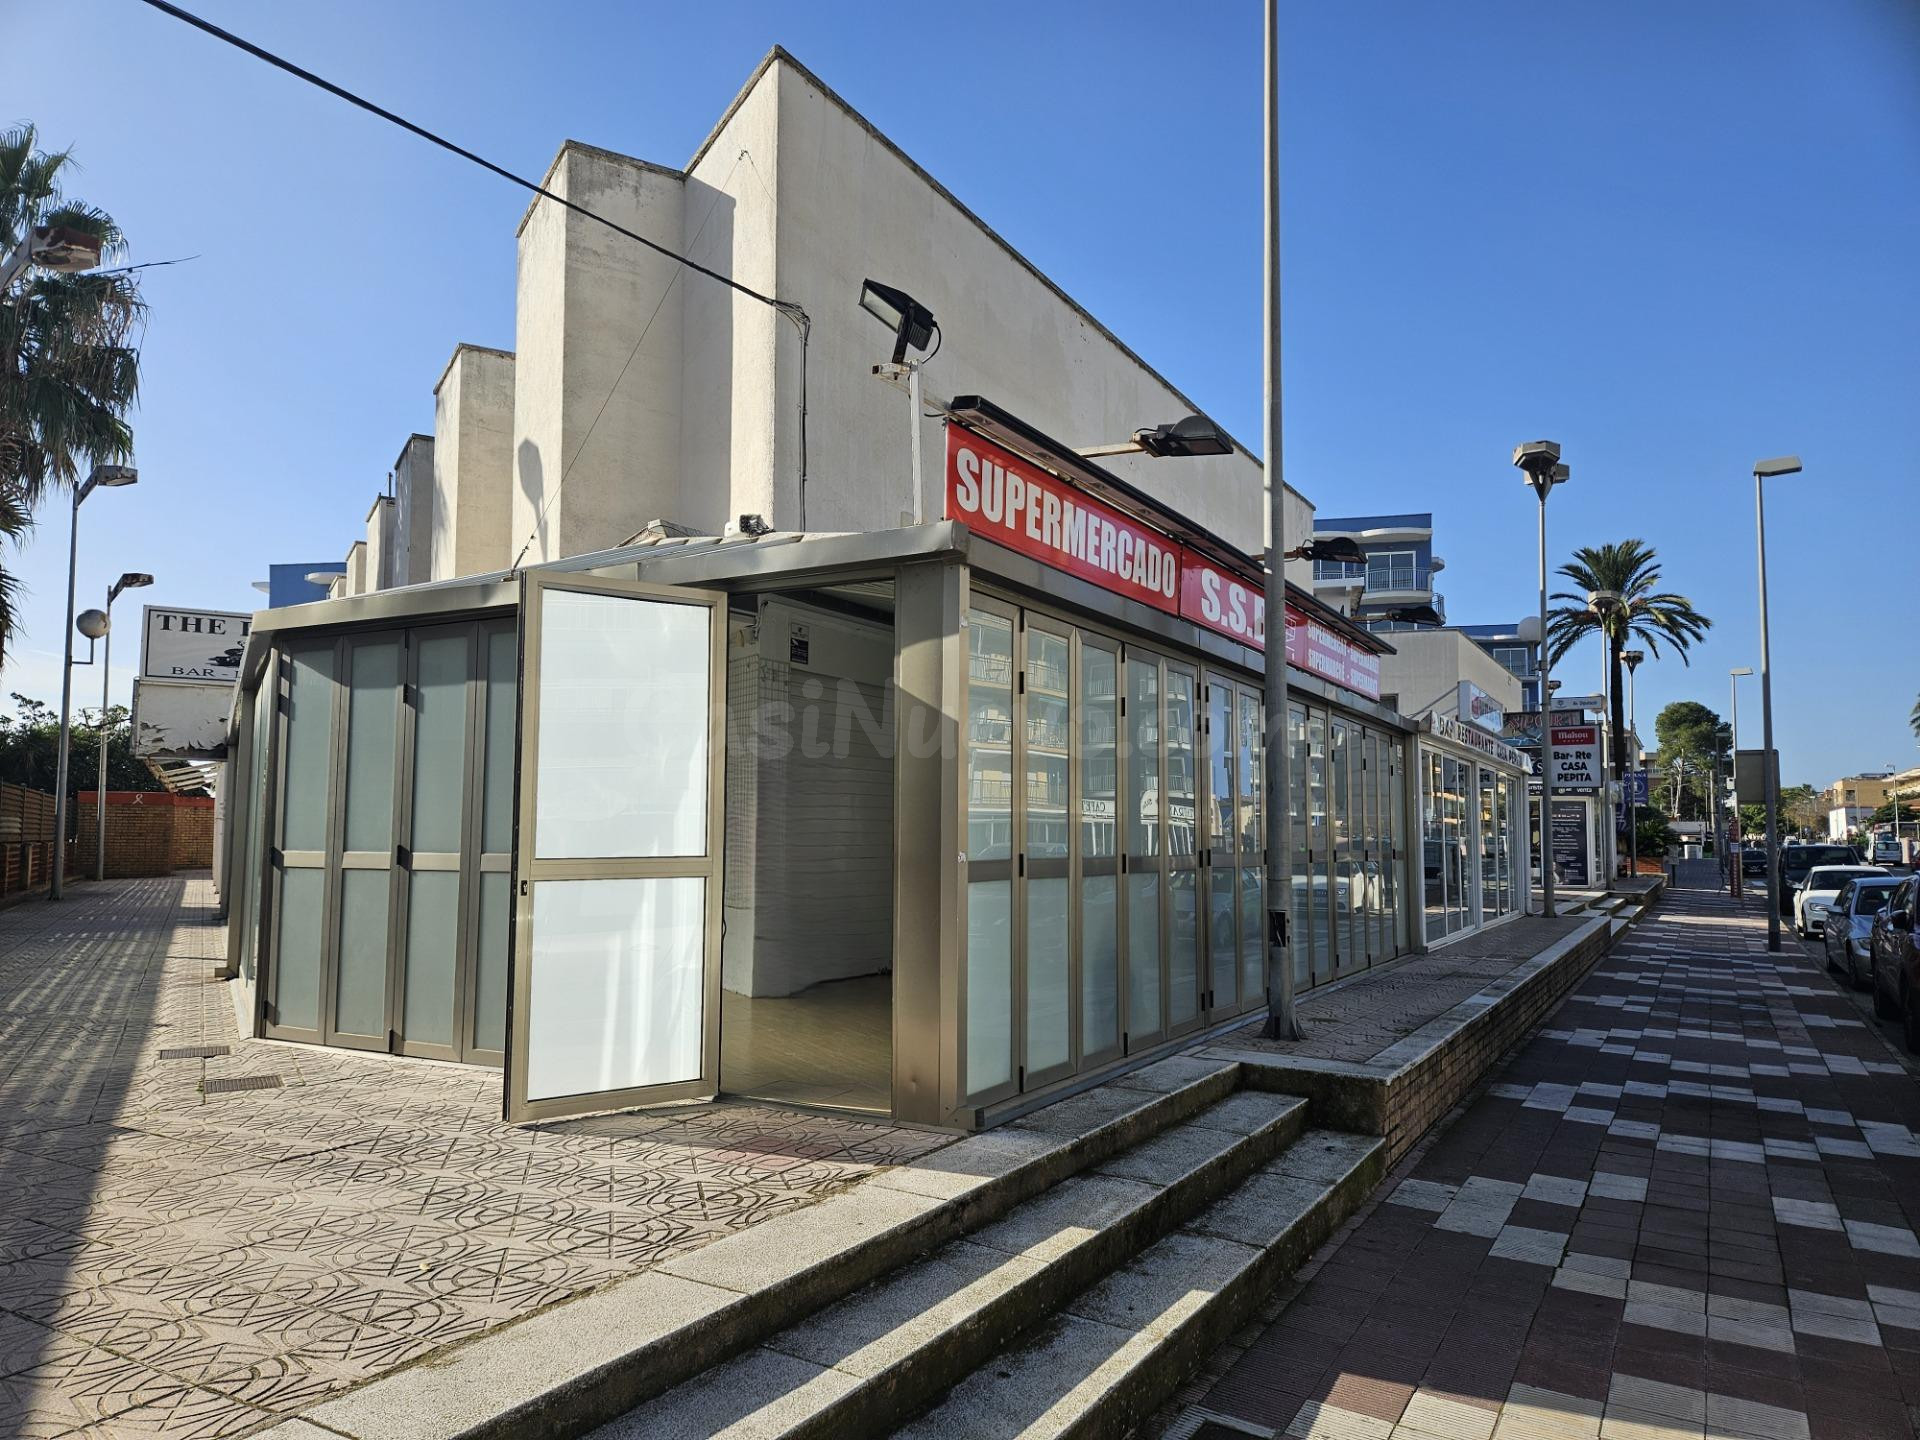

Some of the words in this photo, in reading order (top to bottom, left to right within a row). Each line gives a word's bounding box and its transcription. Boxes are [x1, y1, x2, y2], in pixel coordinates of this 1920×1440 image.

[956, 447, 1176, 598] SUPERMERCADO
[157, 614, 226, 635] THE
[172, 666, 214, 677] BAR
[1457, 724, 1494, 755] RESTAURANTE
[1575, 751, 1592, 760] Rte
[1561, 762, 1588, 771] CASA
[1557, 773, 1592, 782] PEPITA
